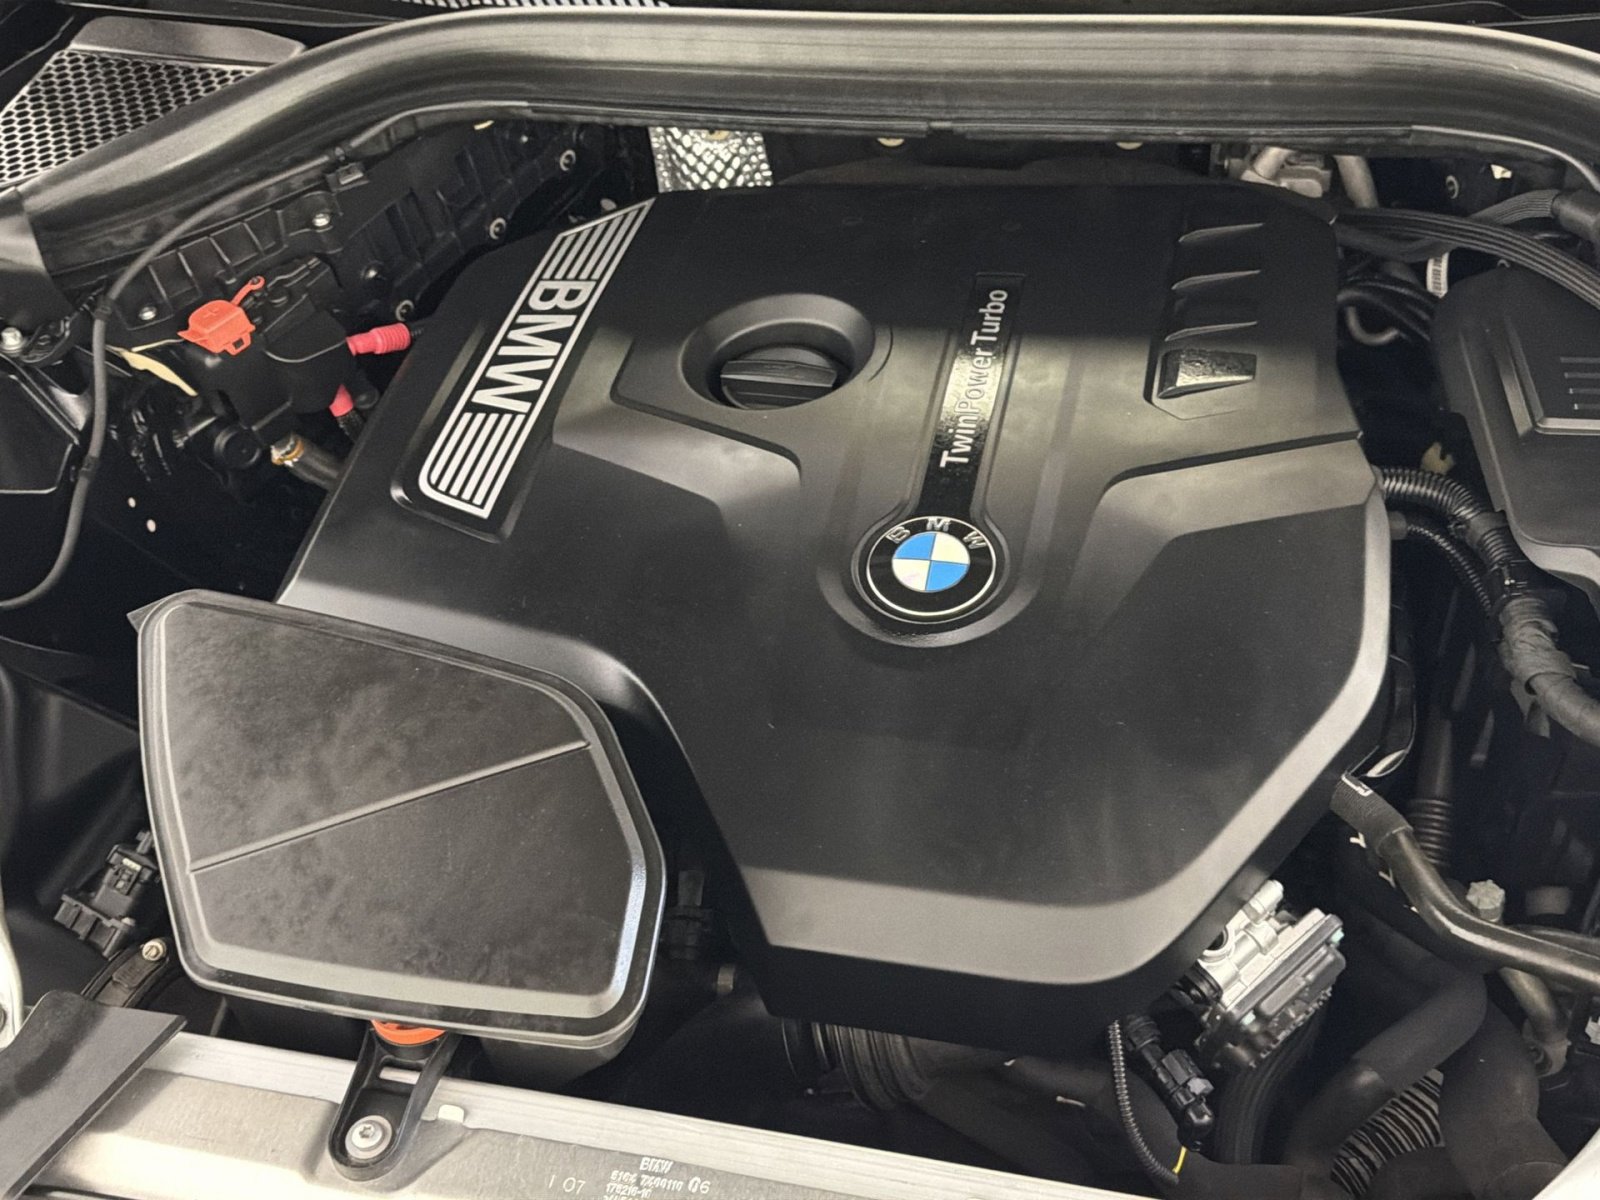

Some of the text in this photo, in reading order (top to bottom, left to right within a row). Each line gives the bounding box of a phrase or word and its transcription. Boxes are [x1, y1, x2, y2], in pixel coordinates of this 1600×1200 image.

[471, 280, 597, 414] BMW
[939, 289, 1009, 468] TwinPower Turbo
[885, 516, 987, 551] BMW
